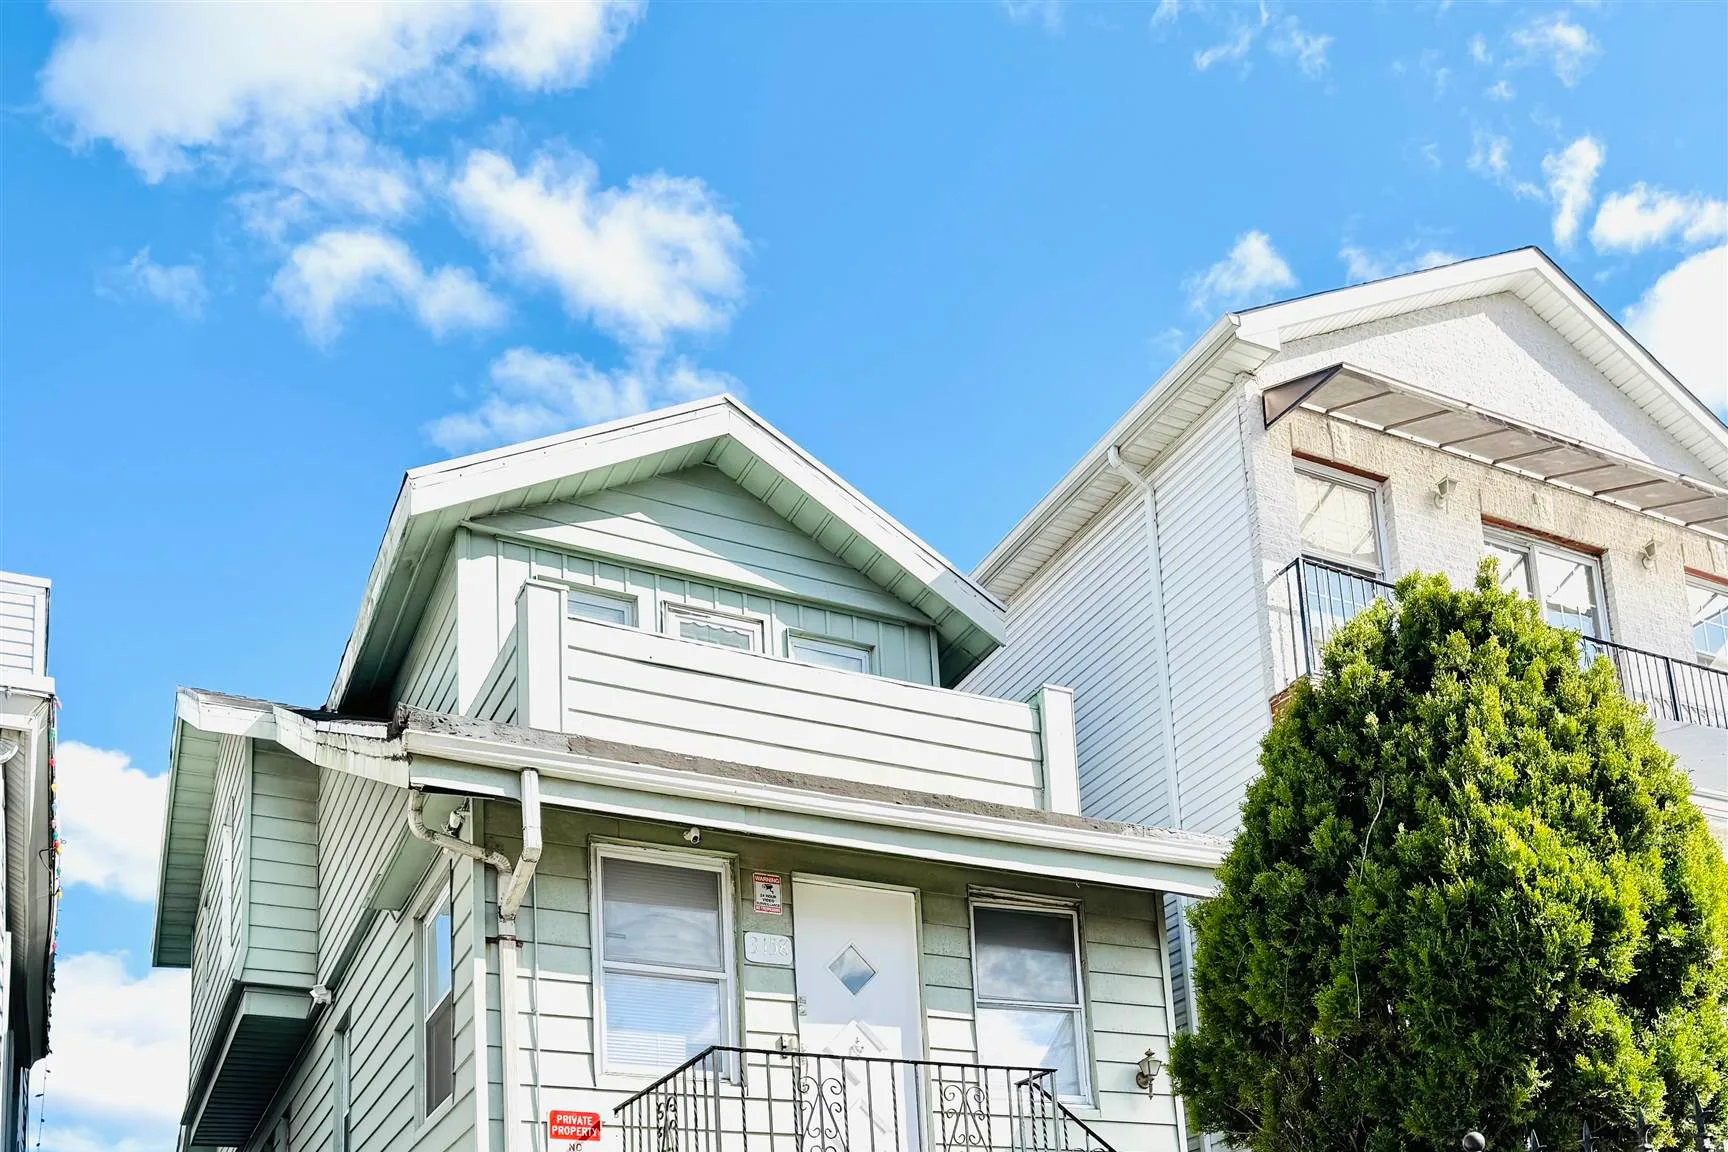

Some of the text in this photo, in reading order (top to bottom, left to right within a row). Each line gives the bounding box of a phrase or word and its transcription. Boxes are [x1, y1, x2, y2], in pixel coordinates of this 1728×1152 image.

[556, 1114, 592, 1126] PRIVATE
[552, 1126, 598, 1136] PROPERTY
[569, 1143, 582, 1152] NO
